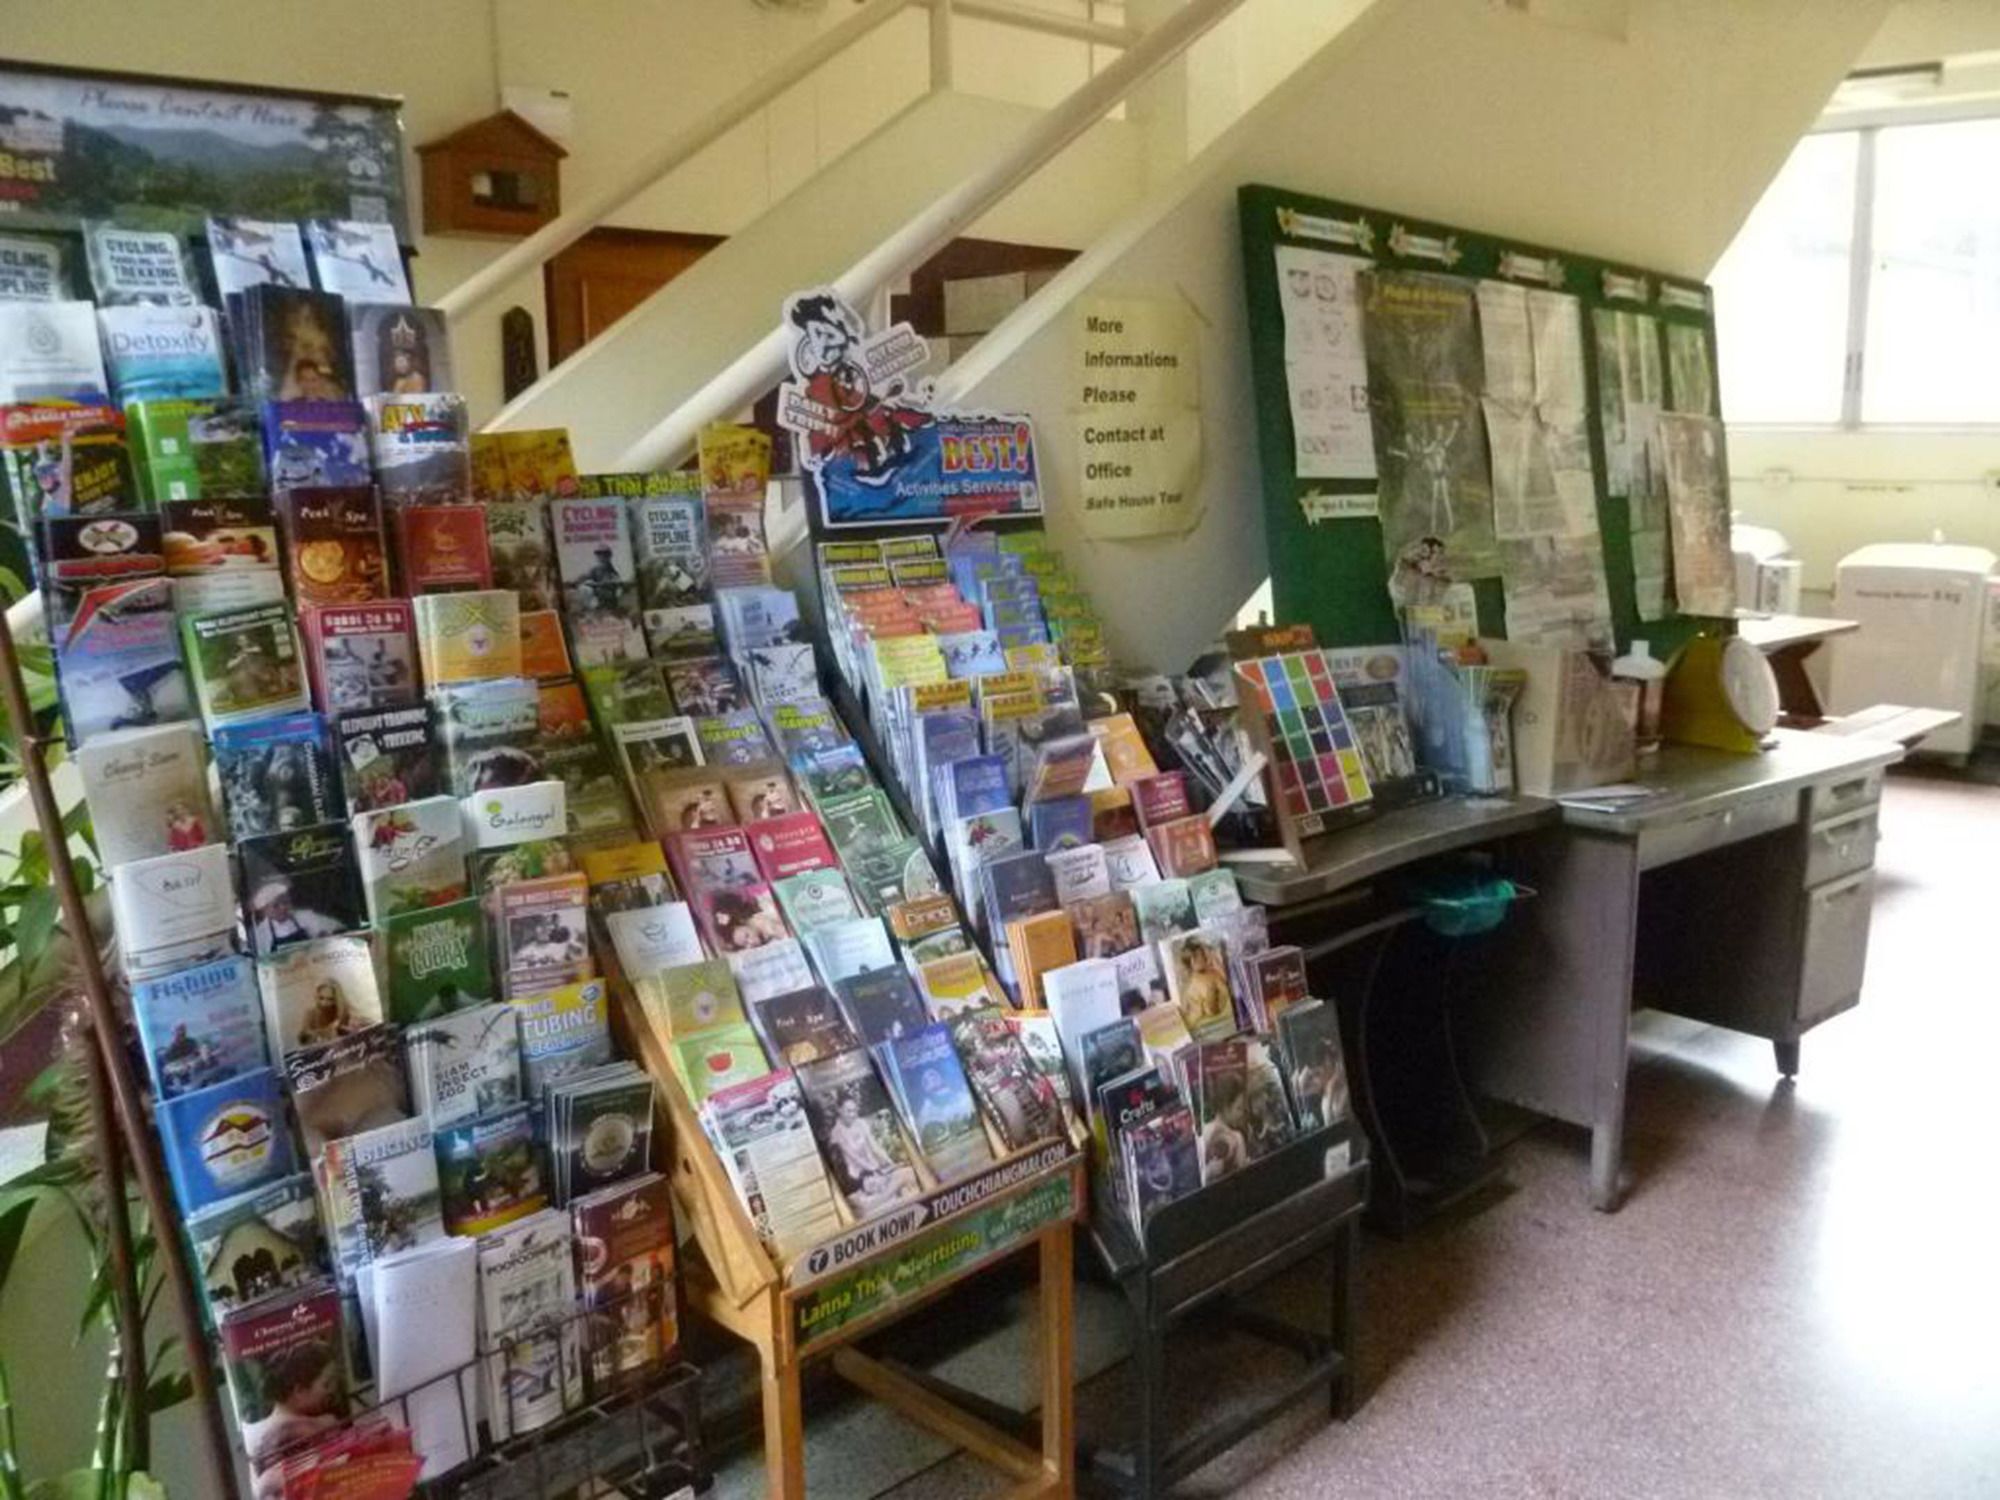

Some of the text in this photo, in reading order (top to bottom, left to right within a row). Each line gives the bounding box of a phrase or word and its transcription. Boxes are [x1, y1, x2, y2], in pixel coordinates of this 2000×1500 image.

[159, 91, 244, 119] Contact
[1086, 316, 1124, 334] More
[111, 332, 209, 352] Detoxify
[1084, 351, 1179, 368] Informations
[1083, 387, 1137, 404] Please
[1084, 426, 1165, 445] Contact at
[1086, 463, 1133, 480] Office
[895, 478, 1021, 497] Activities Services
[1085, 496, 1116, 511] Safe
[1119, 495, 1156, 508] House
[931, 1145, 1069, 1215] TOUCHCHIANGMAI.COM
[833, 1211, 919, 1264] BOOK NOW!
[800, 1231, 981, 1329] Lanna Thai Advertising
